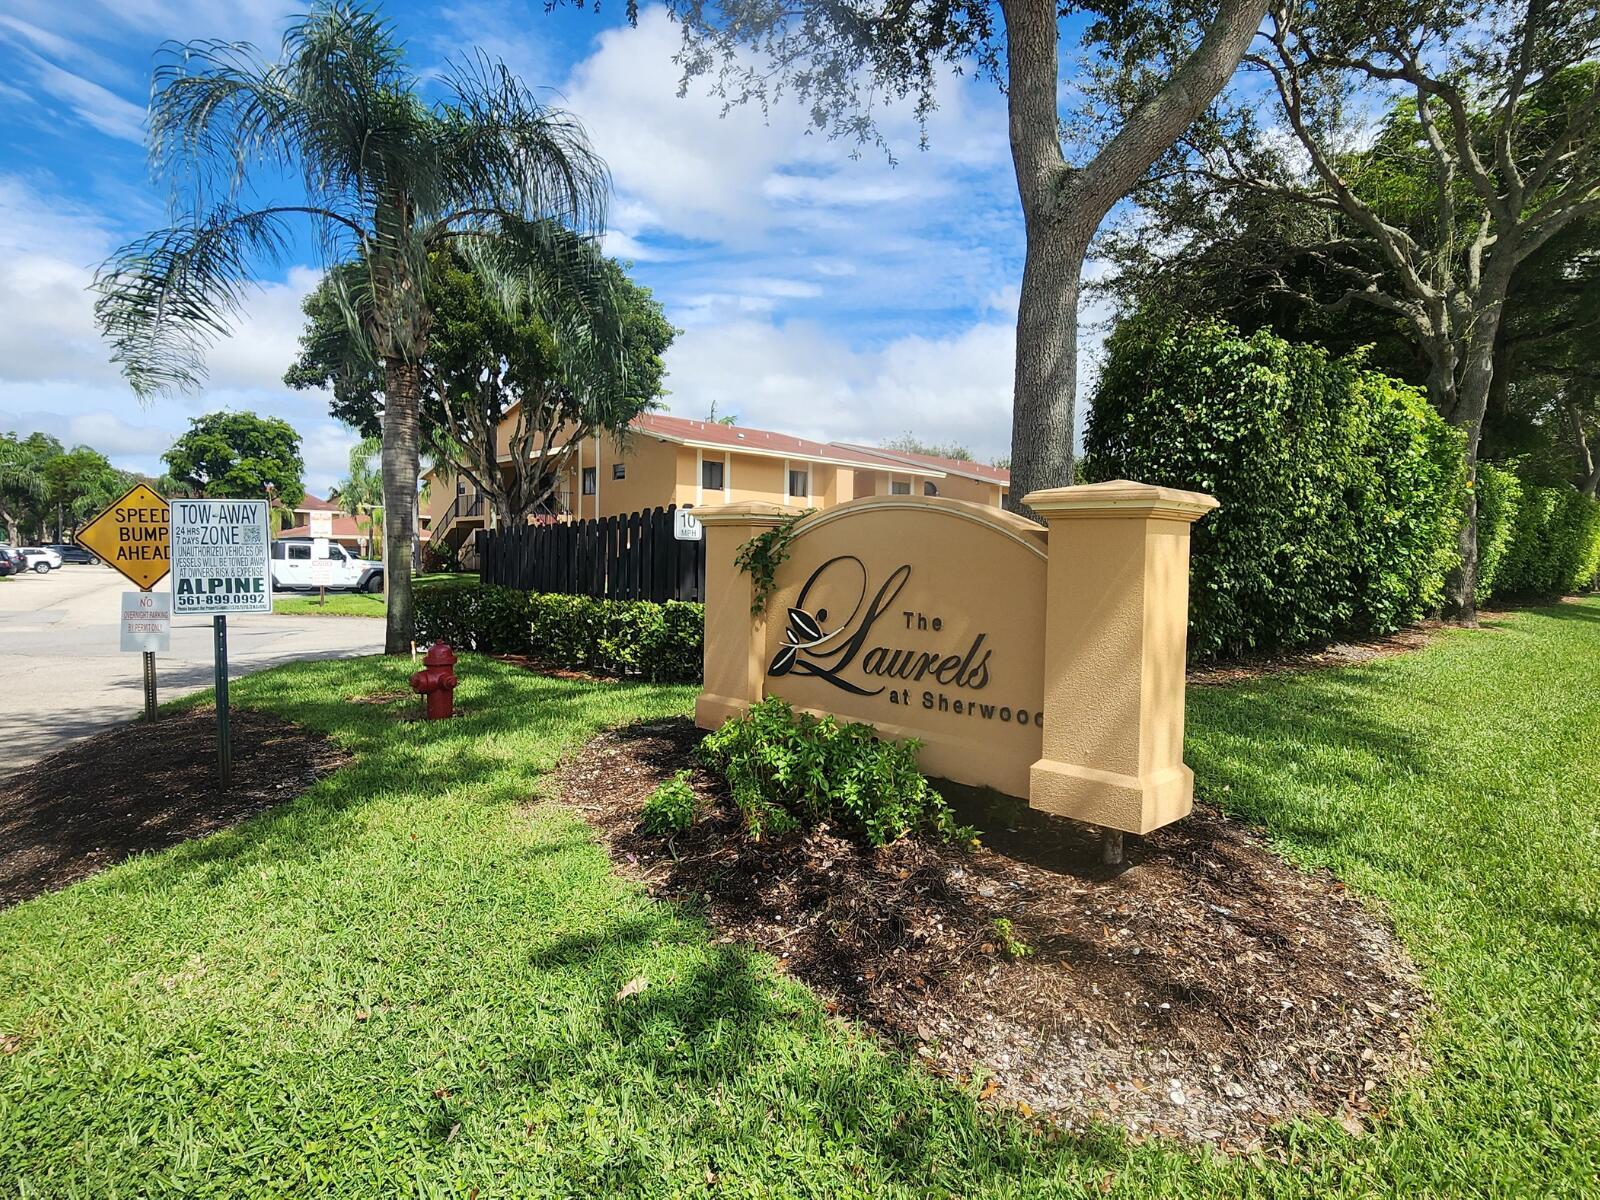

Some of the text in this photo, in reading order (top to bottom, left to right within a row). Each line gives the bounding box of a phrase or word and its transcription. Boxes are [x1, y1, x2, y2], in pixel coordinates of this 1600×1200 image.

[115, 508, 169, 523] SPEED
[180, 504, 257, 524] TOW-AWAY
[681, 513, 695, 528] 10
[120, 527, 168, 541] BUMP
[176, 526, 200, 535] 24 HRS
[200, 525, 239, 545] ZONE
[176, 536, 180, 544] 7
[117, 546, 170, 560] AHEAD
[178, 546, 264, 557] UNAUTHORIZED VEHICLES OR
[176, 557, 265, 567] VESSELS WILL BE TOWED AWAY
[180, 567, 263, 577] AT OWNERS RISK & EXPENSE
[177, 578, 265, 594] ALPINE
[140, 599, 153, 607] NO
[179, 594, 265, 605] 561-899.0992
[789, 555, 993, 697] Laurels
[903, 611, 943, 631] The
[889, 687, 910, 705] at
